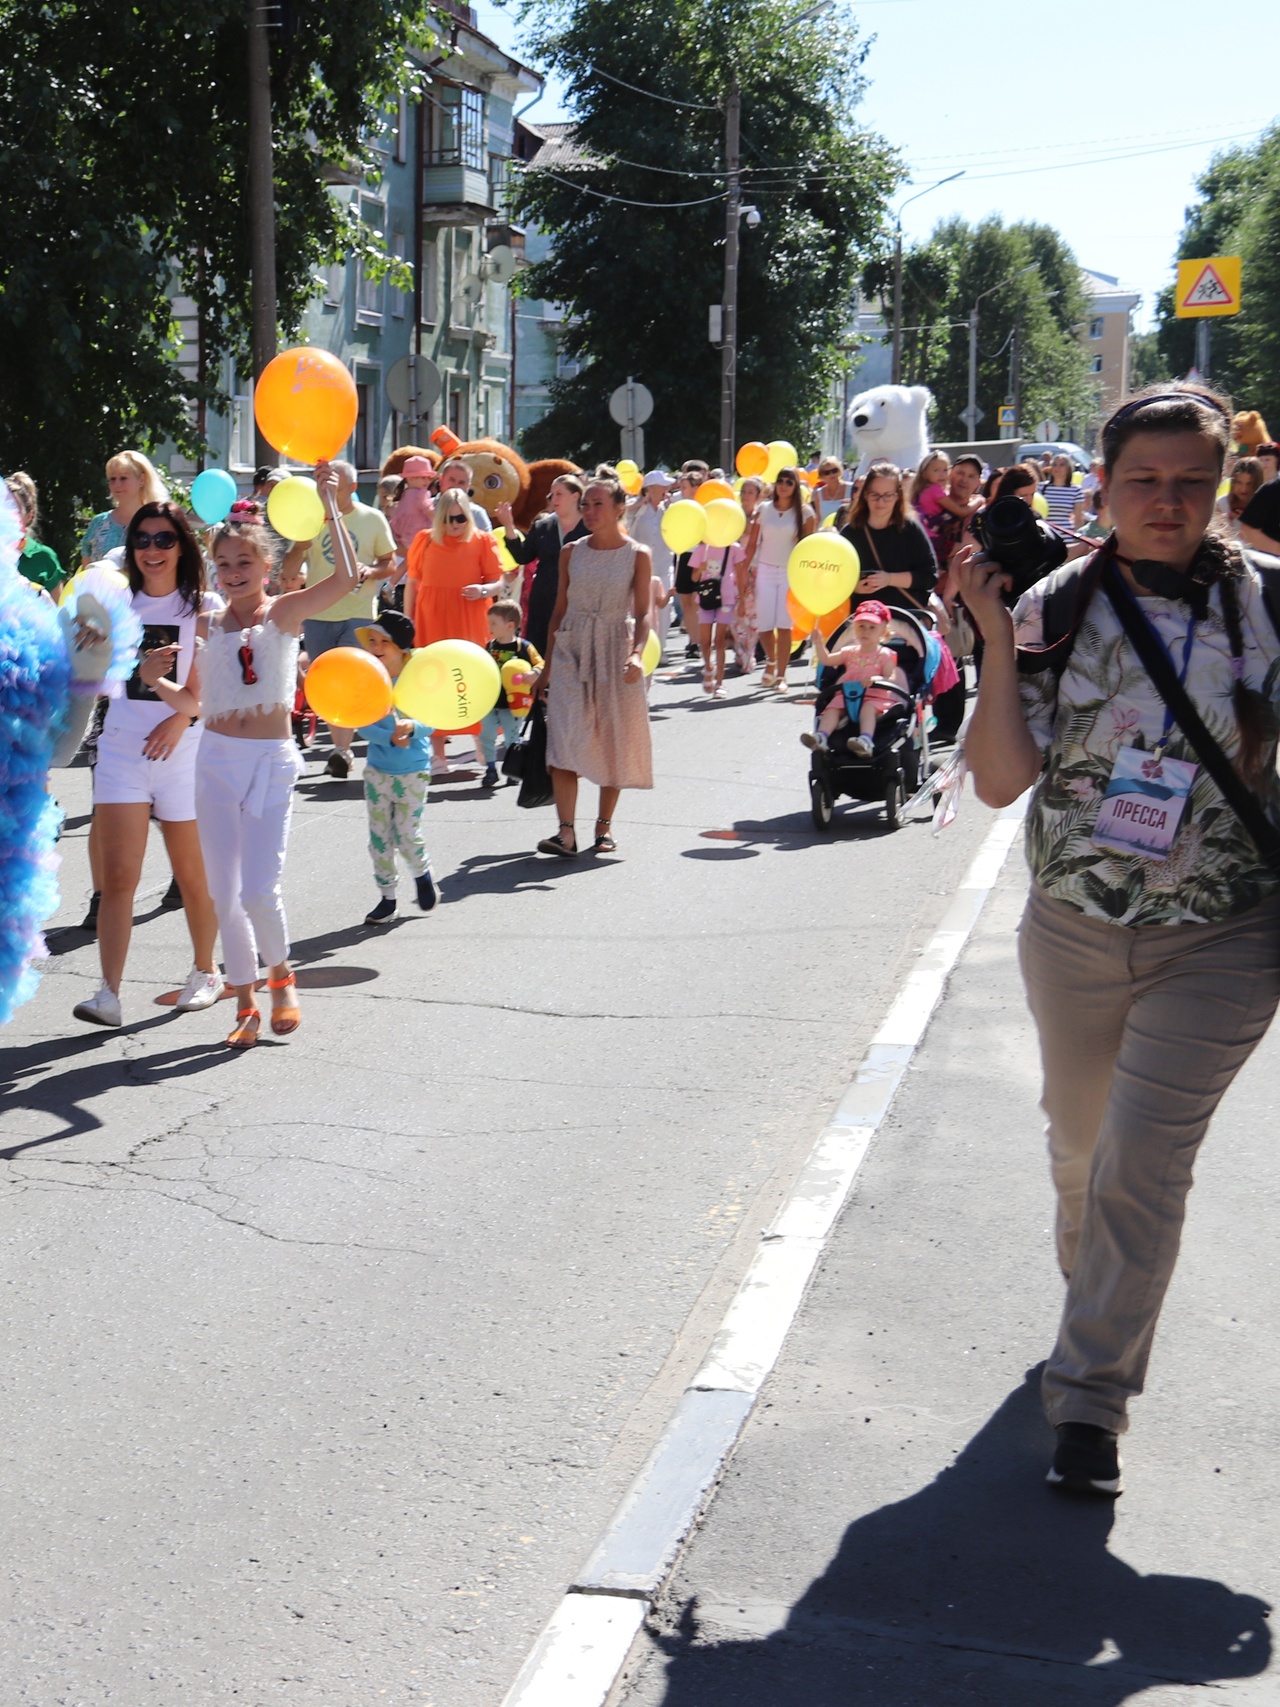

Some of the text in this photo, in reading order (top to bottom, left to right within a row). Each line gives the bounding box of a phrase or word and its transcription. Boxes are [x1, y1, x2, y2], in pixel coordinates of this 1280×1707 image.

[799, 560, 841, 573] maxim
[451, 667, 471, 718] maxim
[1112, 798, 1168, 831] ПРЕССА
